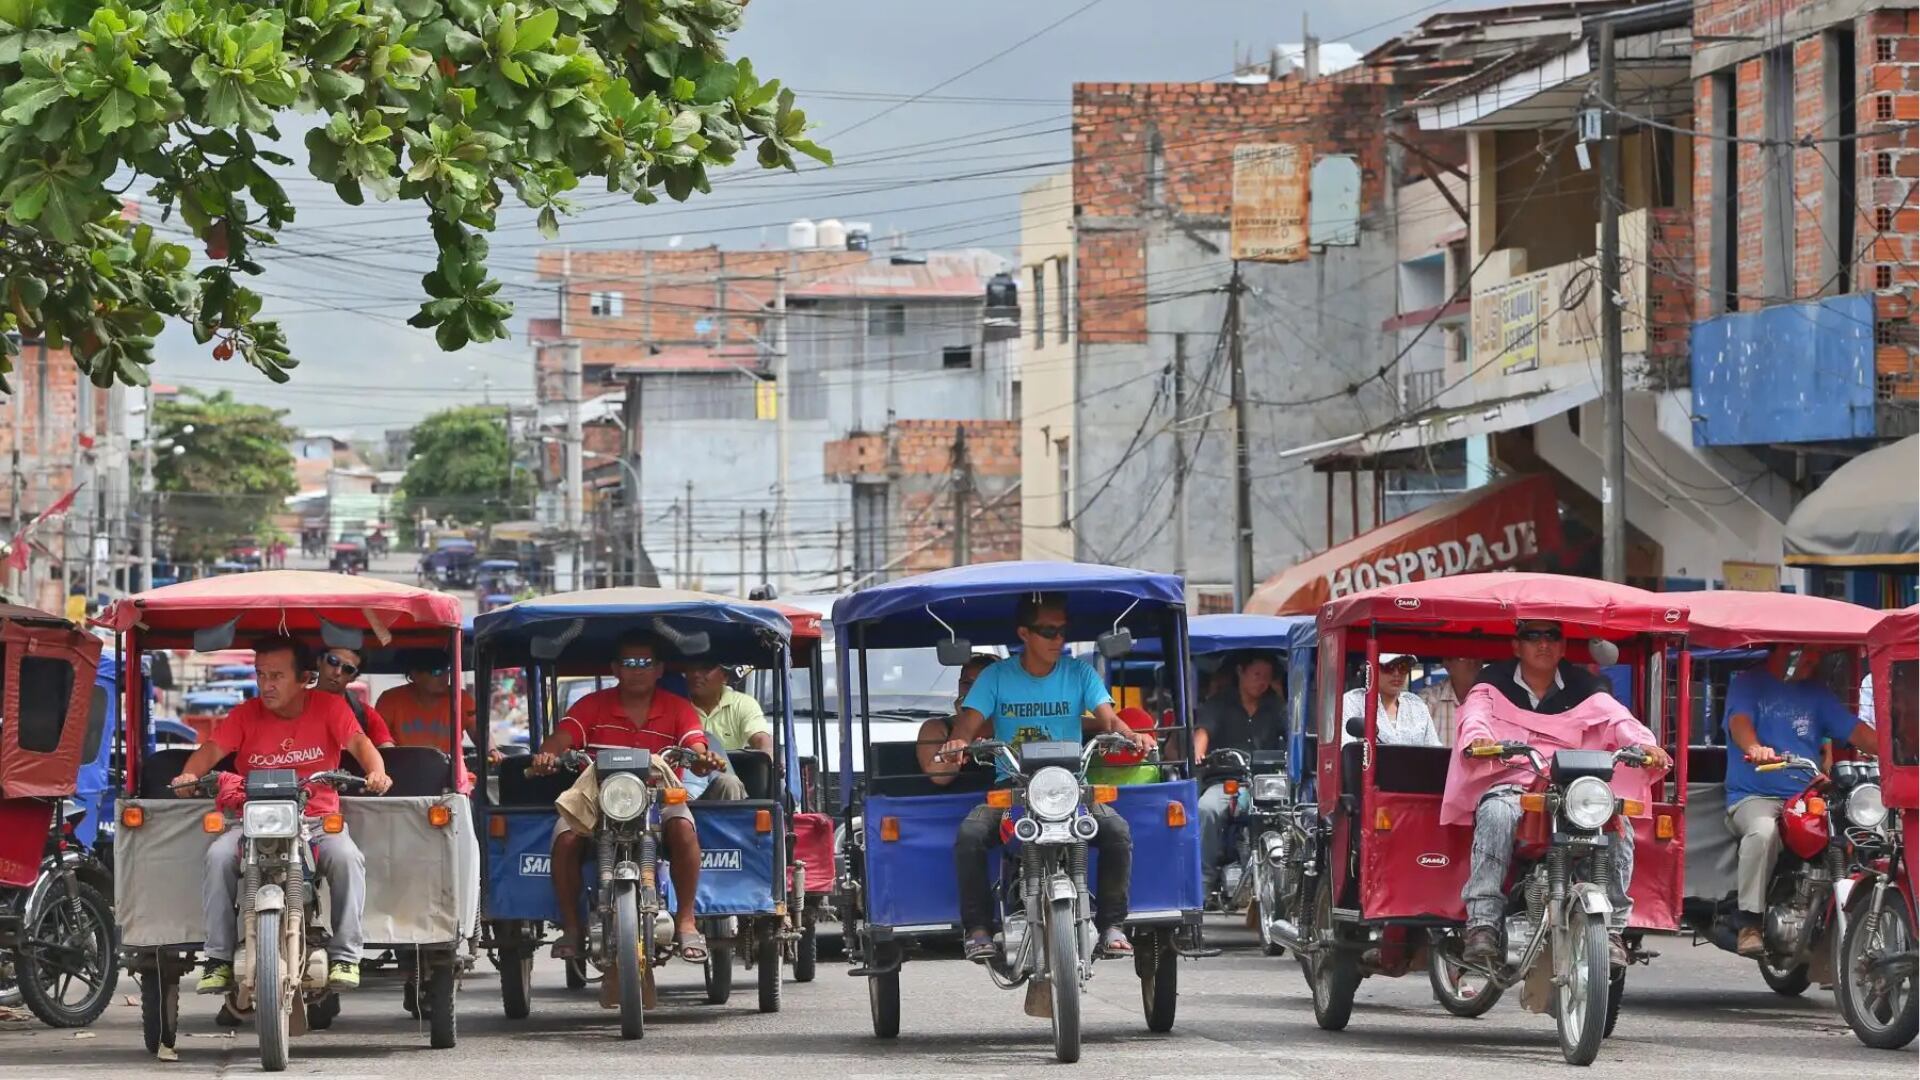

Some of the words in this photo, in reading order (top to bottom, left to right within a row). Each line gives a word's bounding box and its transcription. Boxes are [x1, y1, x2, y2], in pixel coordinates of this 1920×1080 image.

[1329, 520, 1538, 601] HOSPEDAJE
[1000, 701, 1069, 717] CATERPILLAR
[522, 856, 551, 873] SAM
